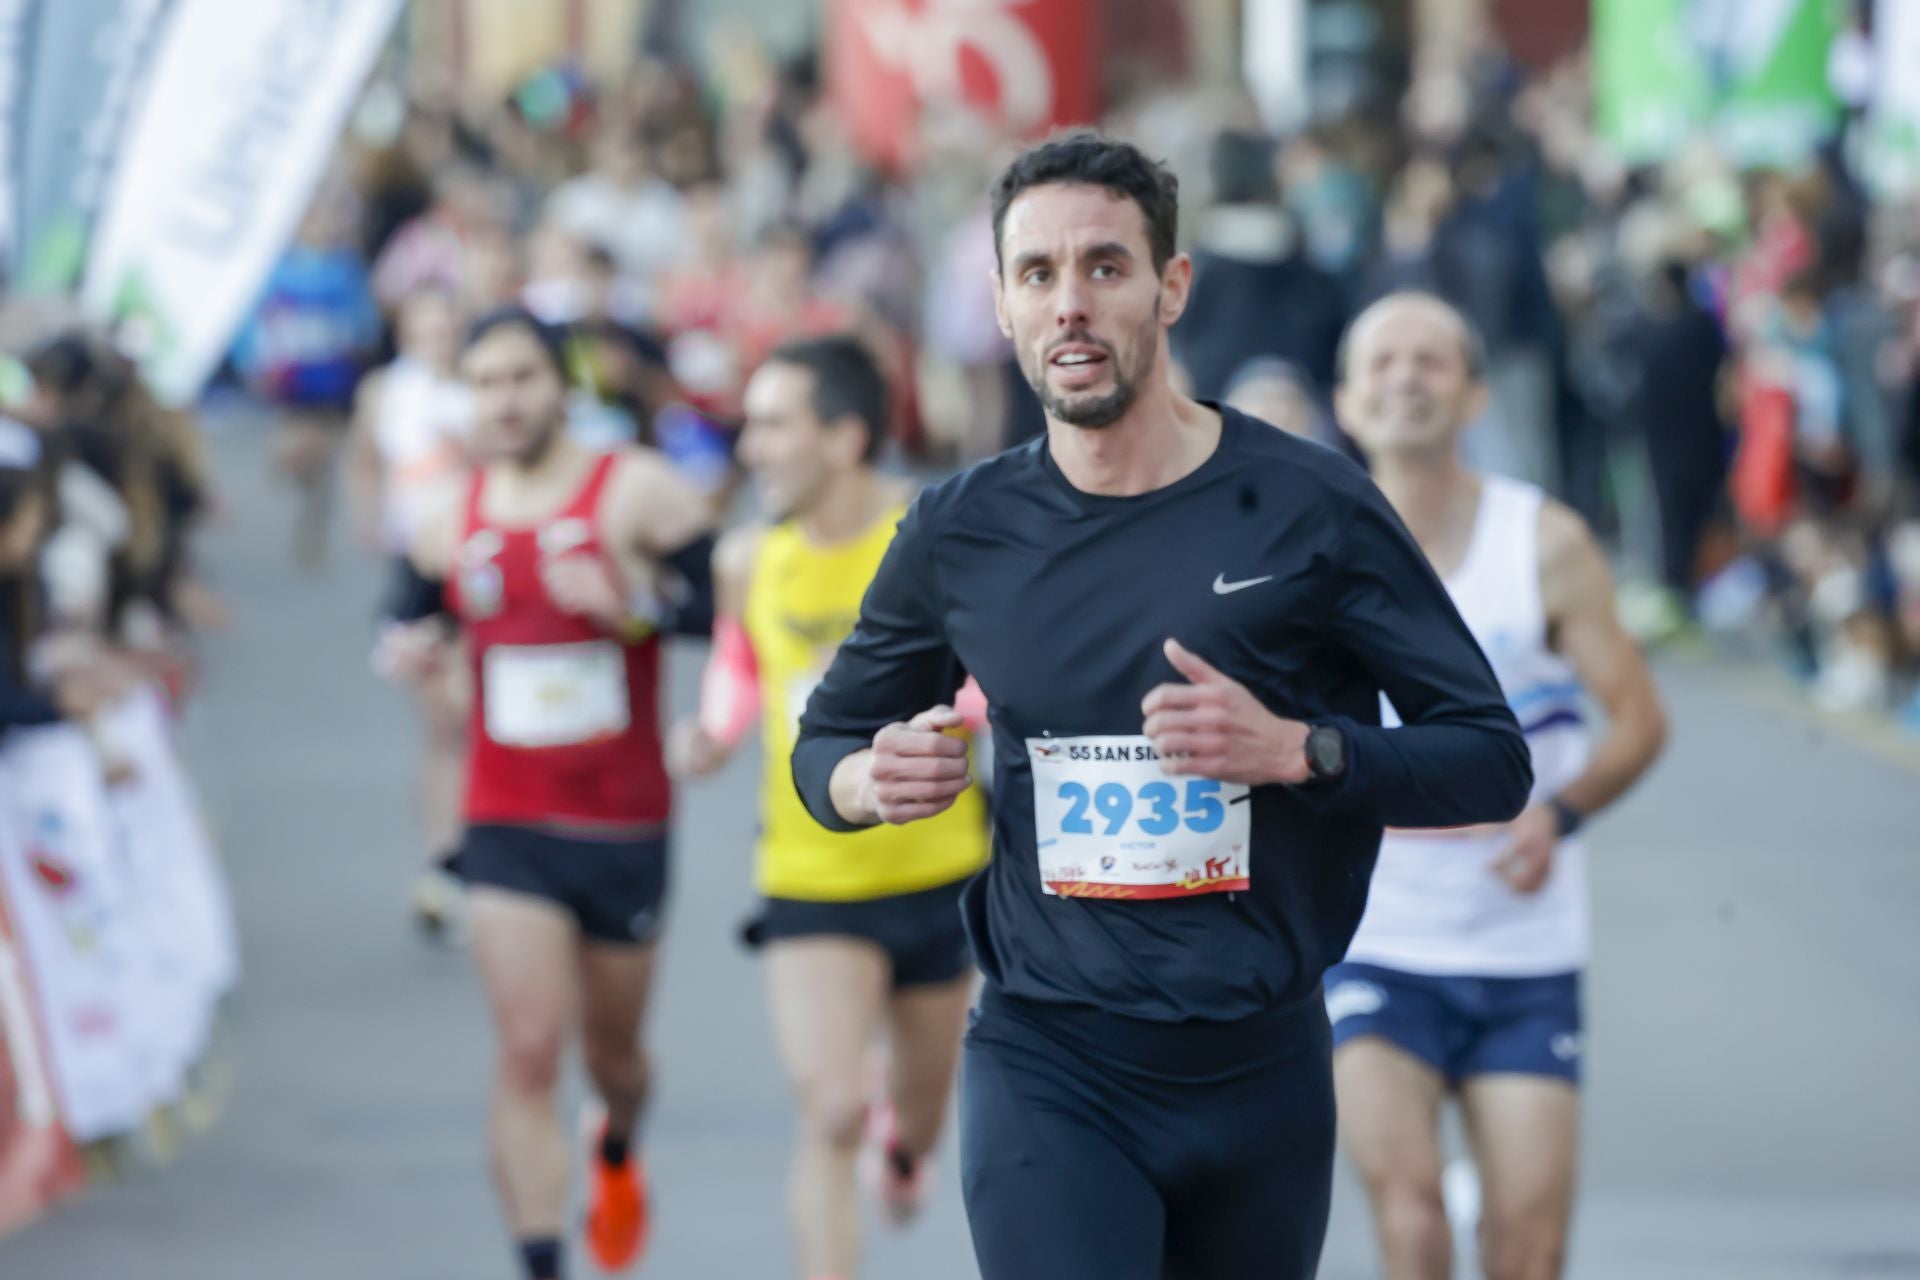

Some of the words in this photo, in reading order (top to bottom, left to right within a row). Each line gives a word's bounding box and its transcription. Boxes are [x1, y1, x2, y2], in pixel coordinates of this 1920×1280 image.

[1070, 746, 1091, 760] 55
[1095, 746, 1130, 761] SAN
[1057, 780, 1226, 836] 2935
